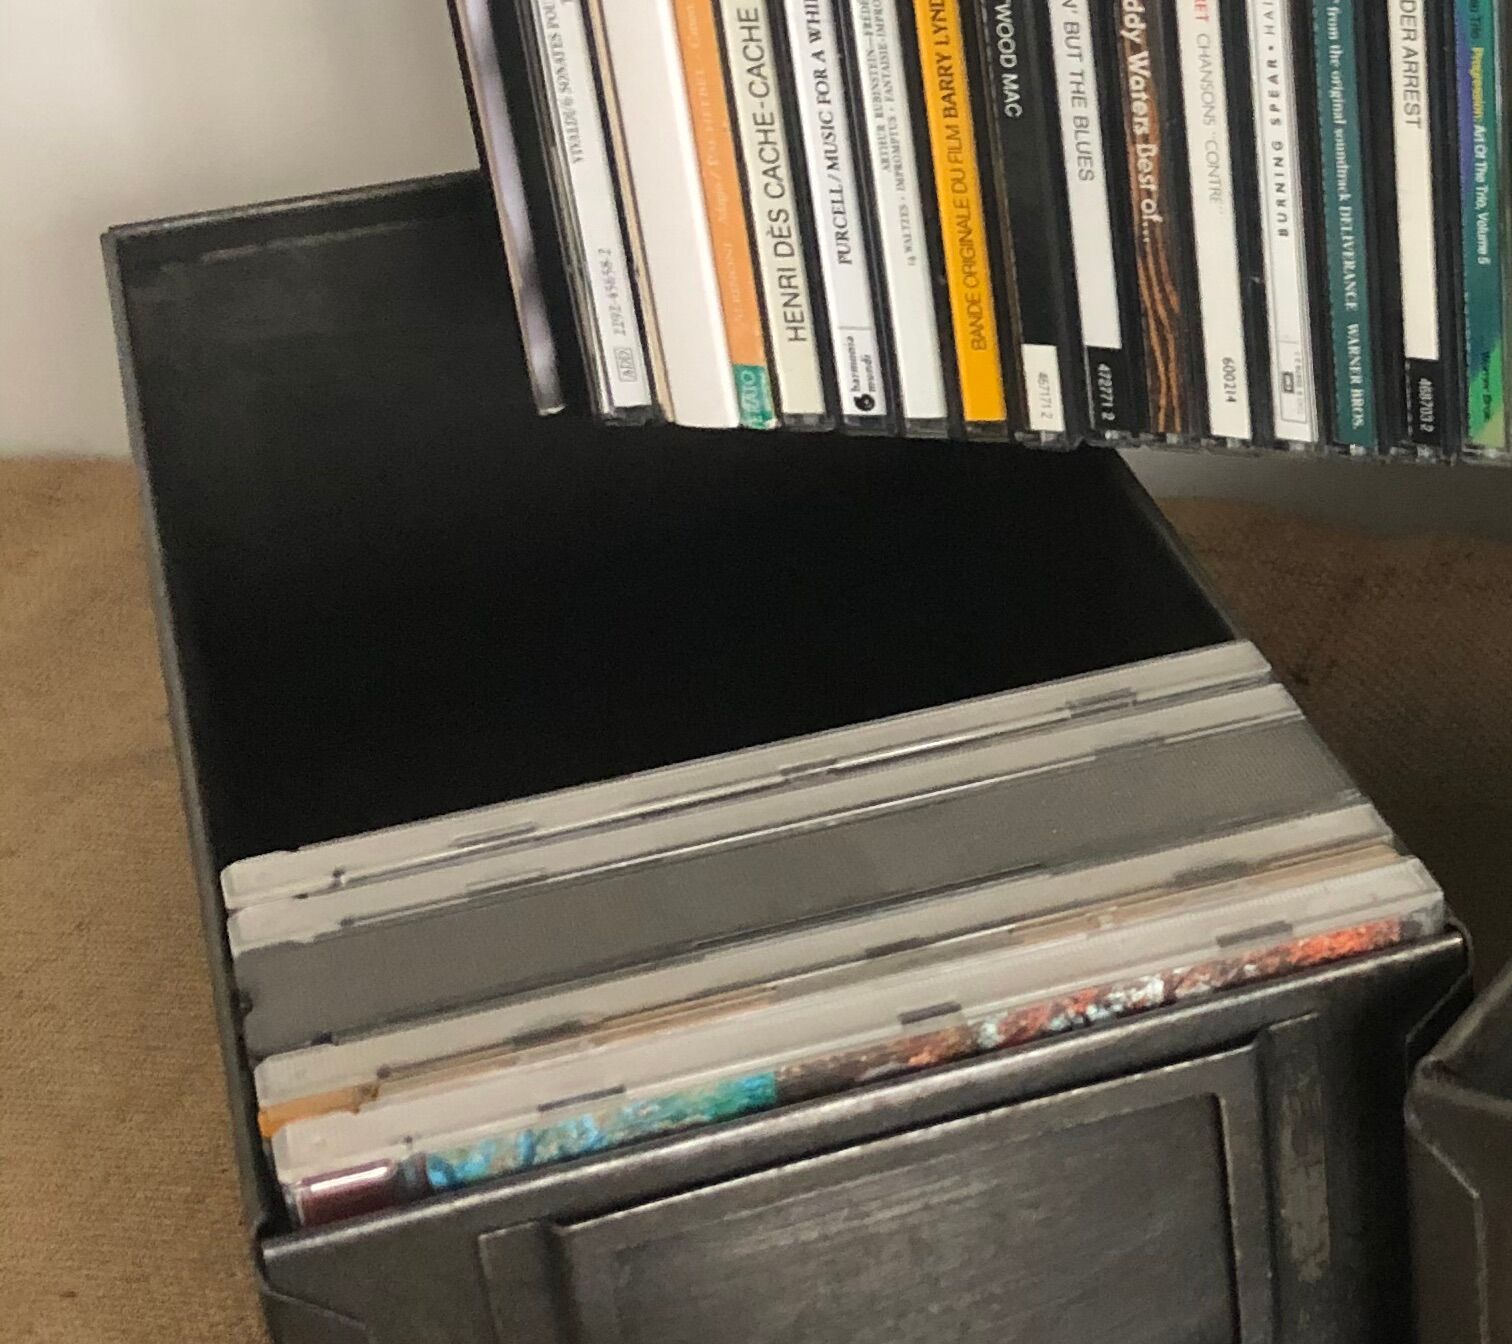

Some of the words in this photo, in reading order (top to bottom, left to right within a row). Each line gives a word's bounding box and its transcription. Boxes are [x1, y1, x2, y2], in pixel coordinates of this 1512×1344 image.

[1062, 21, 1083, 64] BUT
[1325, 6, 1342, 41] from
[810, 48, 826, 63] A
[1195, 31, 1218, 128] CHANSONS
[1328, 43, 1344, 68] the
[736, 6, 786, 199] CACHE-CACHE
[812, 67, 832, 105] FOR
[935, 53, 959, 120] BARRY
[1001, 73, 1024, 119] MAC
[1068, 67, 1088, 109] THE
[1126, 49, 1152, 137] Waters
[1265, 58, 1283, 127] SPEAR
[1328, 69, 1347, 125] original
[1400, 46, 1422, 129] ARREST
[887, 115, 907, 193] IMPROMPTUS
[942, 122, 963, 164] FILM
[1072, 114, 1095, 183] BLUES
[1135, 142, 1159, 193] Best
[1333, 127, 1352, 202] soundtrack
[947, 166, 968, 193] DU
[1271, 140, 1290, 238] BURNING
[1474, 161, 1489, 184] The
[766, 207, 796, 258] DÈS
[897, 202, 915, 254] WALTZES
[951, 198, 981, 289] ORIGINALE
[1476, 211, 1490, 256] Volume
[1337, 205, 1359, 312] DELIVERANCE
[776, 266, 807, 342] HENRI
[965, 291, 988, 351] BANDE
[1221, 356, 1237, 403] 600214
[1345, 322, 1365, 385] WARNER
[1101, 411, 1116, 421] 2
[1350, 388, 1366, 430] BROS.
